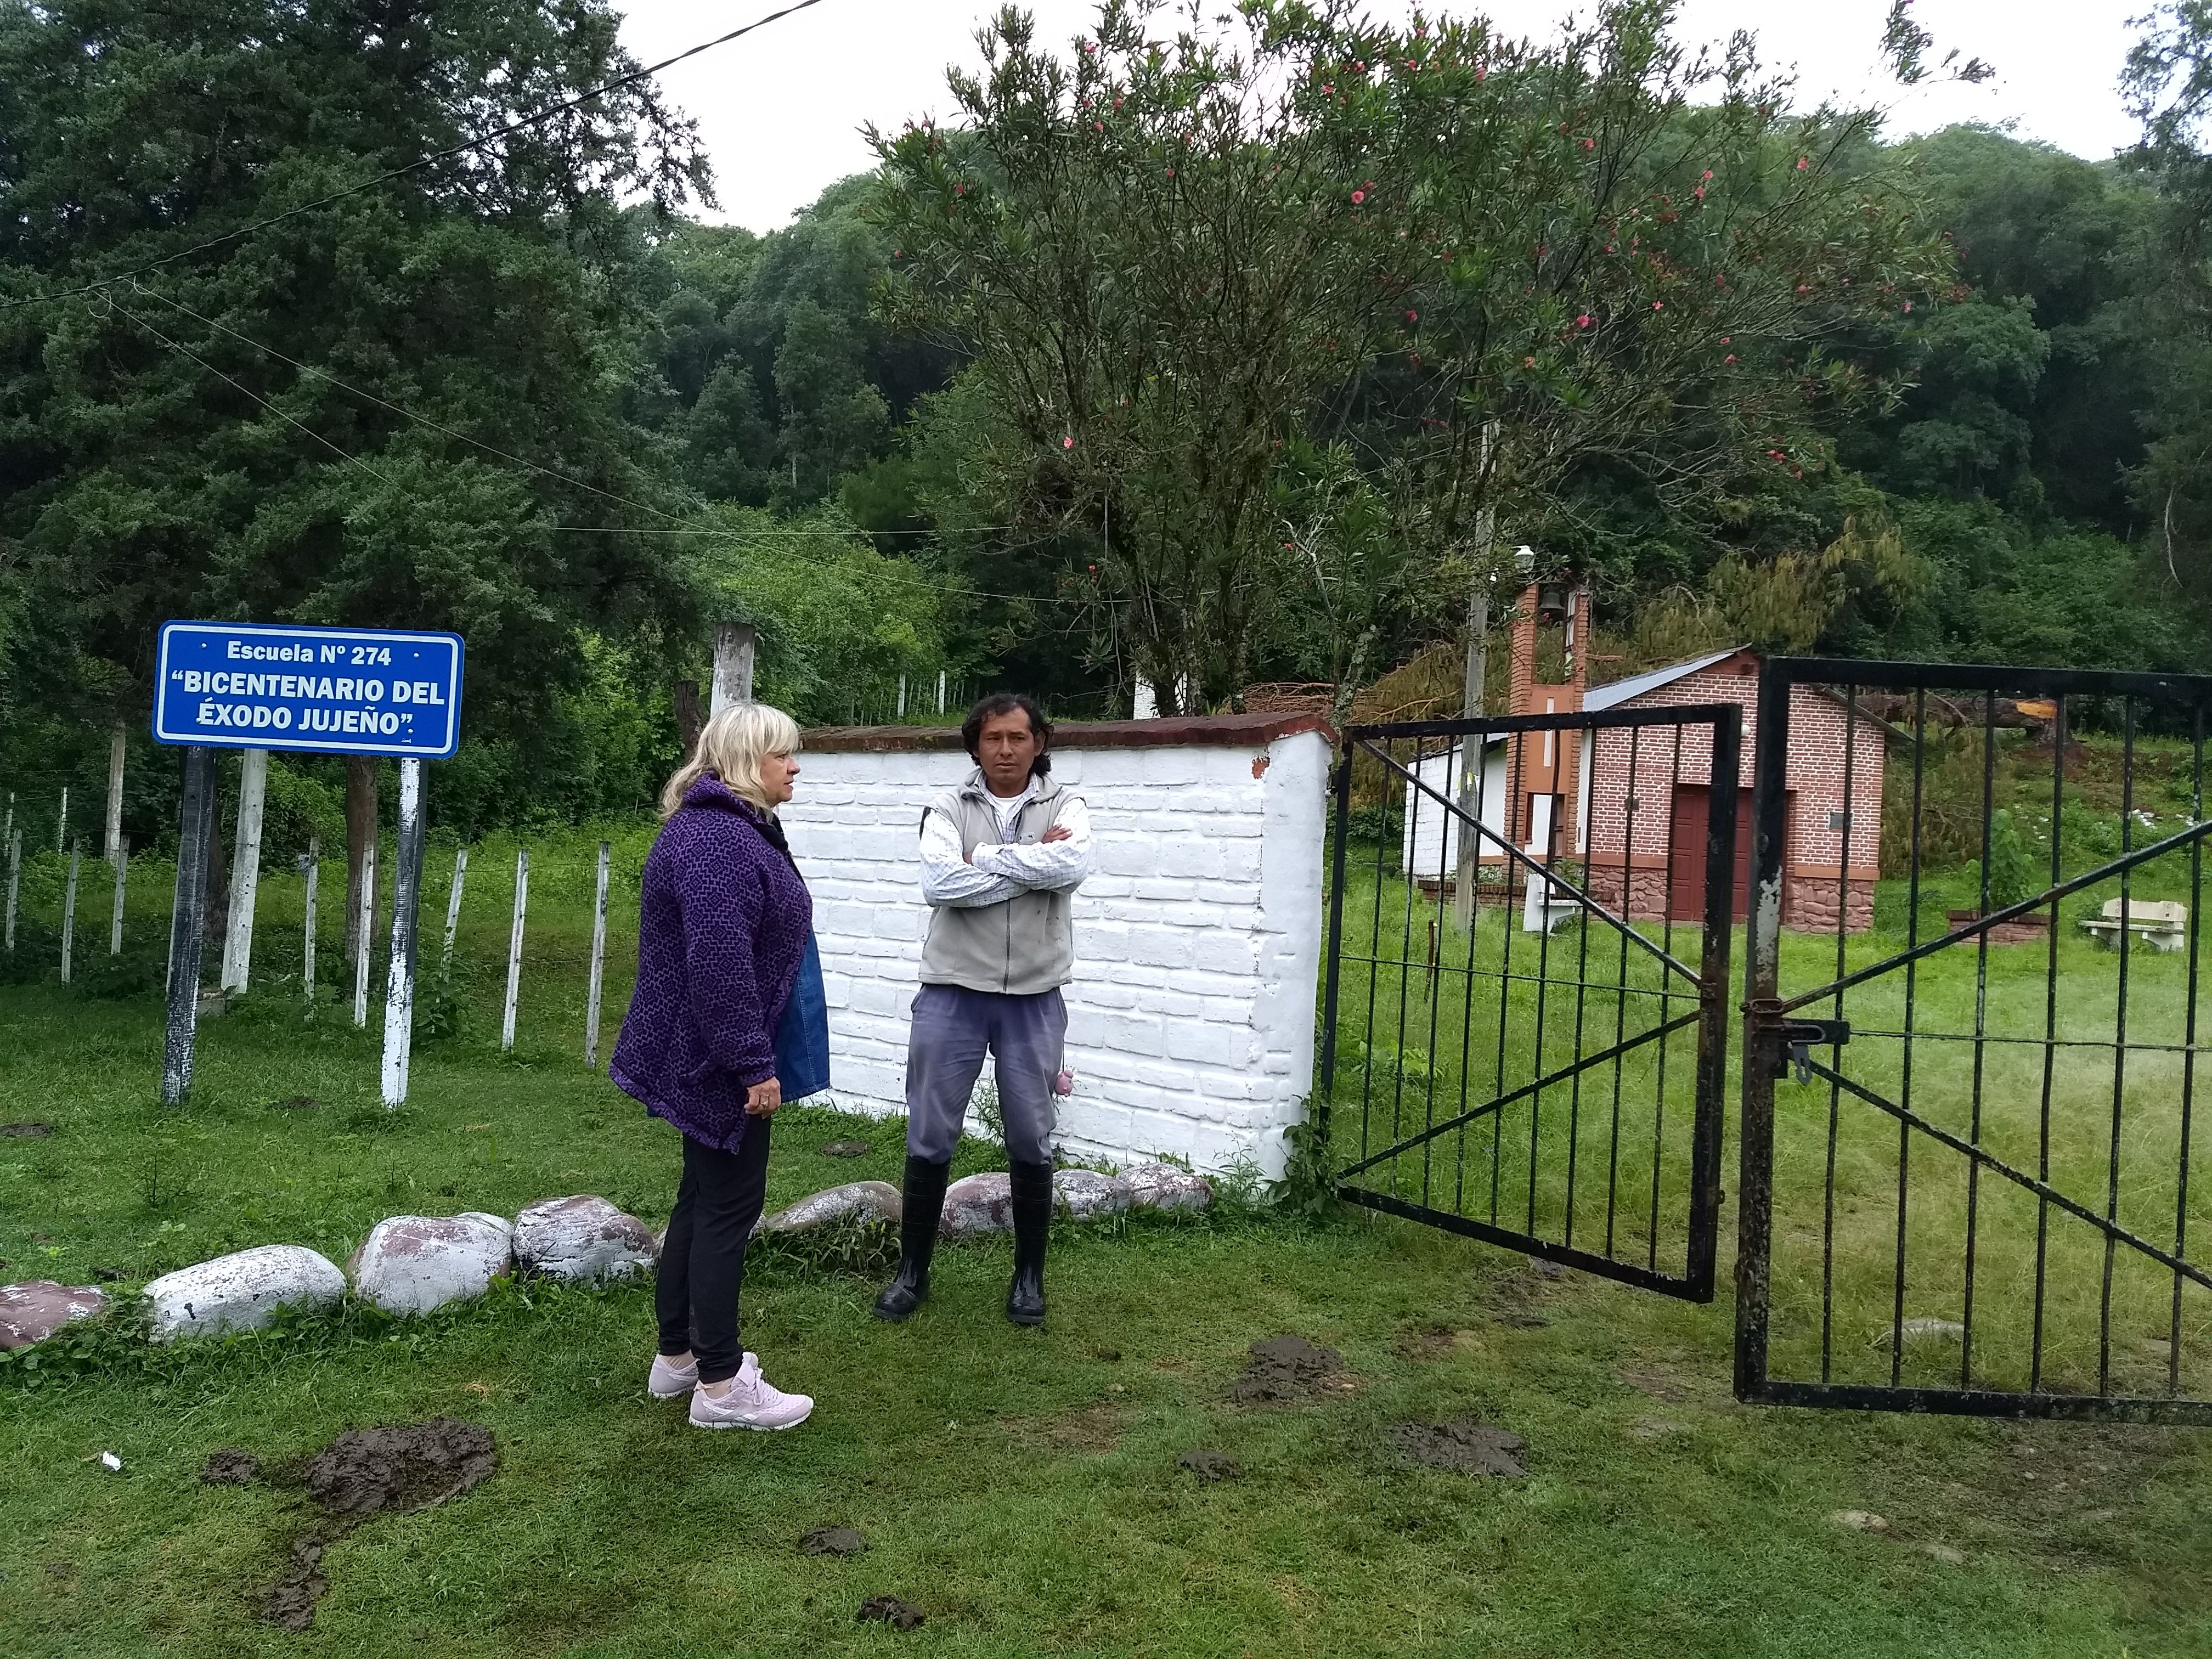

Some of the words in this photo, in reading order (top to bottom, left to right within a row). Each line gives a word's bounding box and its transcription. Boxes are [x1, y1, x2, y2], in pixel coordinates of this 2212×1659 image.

[227, 640, 314, 662] Escuela
[351, 646, 392, 666] 274
[171, 670, 384, 702] “BICENTENARIO
[392, 680, 444, 705] DEL
[199, 696, 292, 729] ÉXODO
